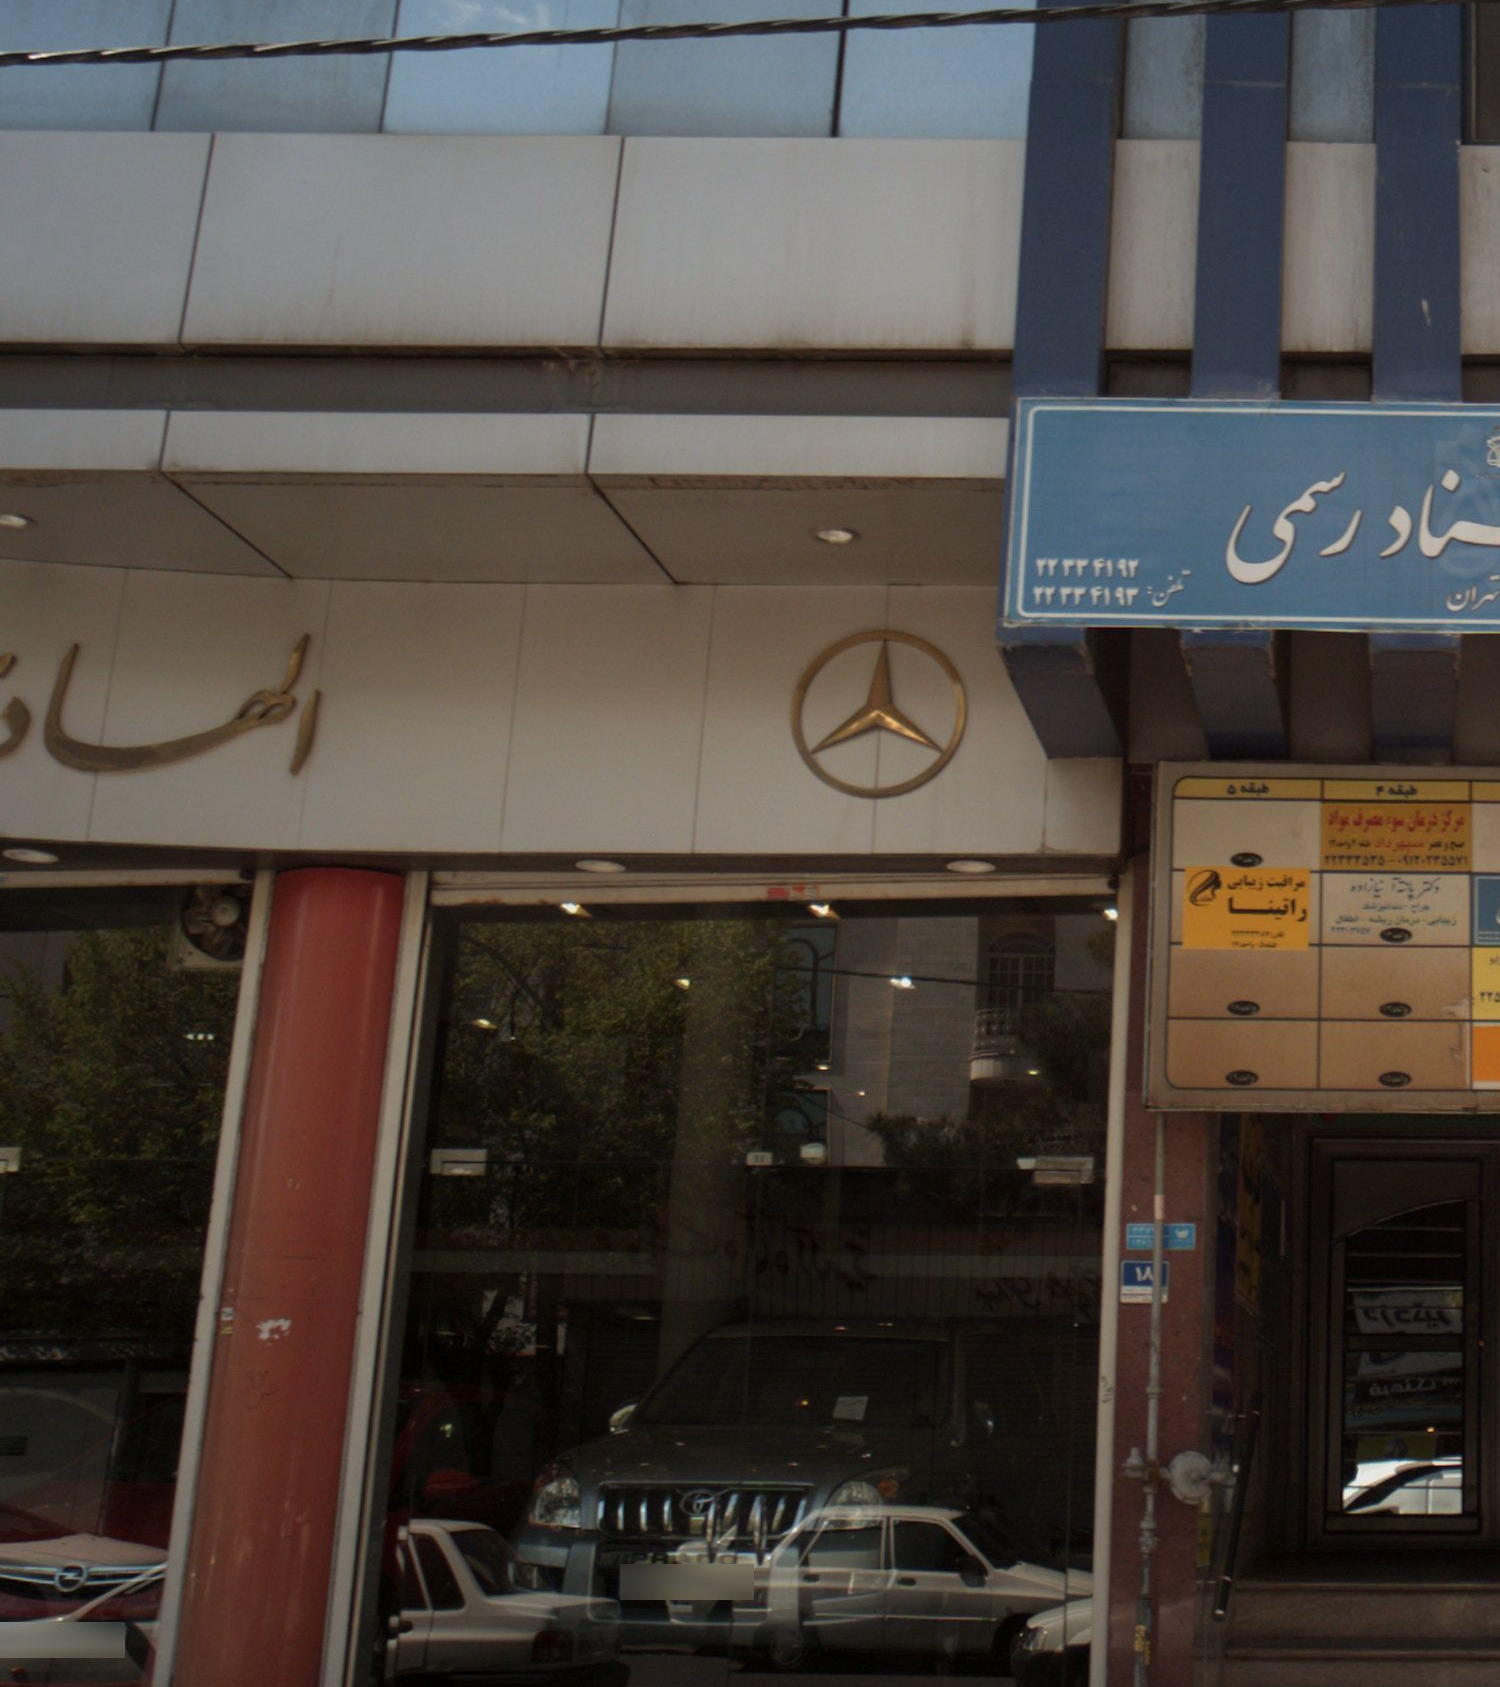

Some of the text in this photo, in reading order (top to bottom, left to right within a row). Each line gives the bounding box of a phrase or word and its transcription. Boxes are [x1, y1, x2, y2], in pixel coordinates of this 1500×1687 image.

[1225, 469, 1362, 585] رسمی
[1445, 574, 1500, 612] تهران
[1226, 784, 1269, 796] طبقه ۵
[1388, 784, 1418, 798] طبقه
